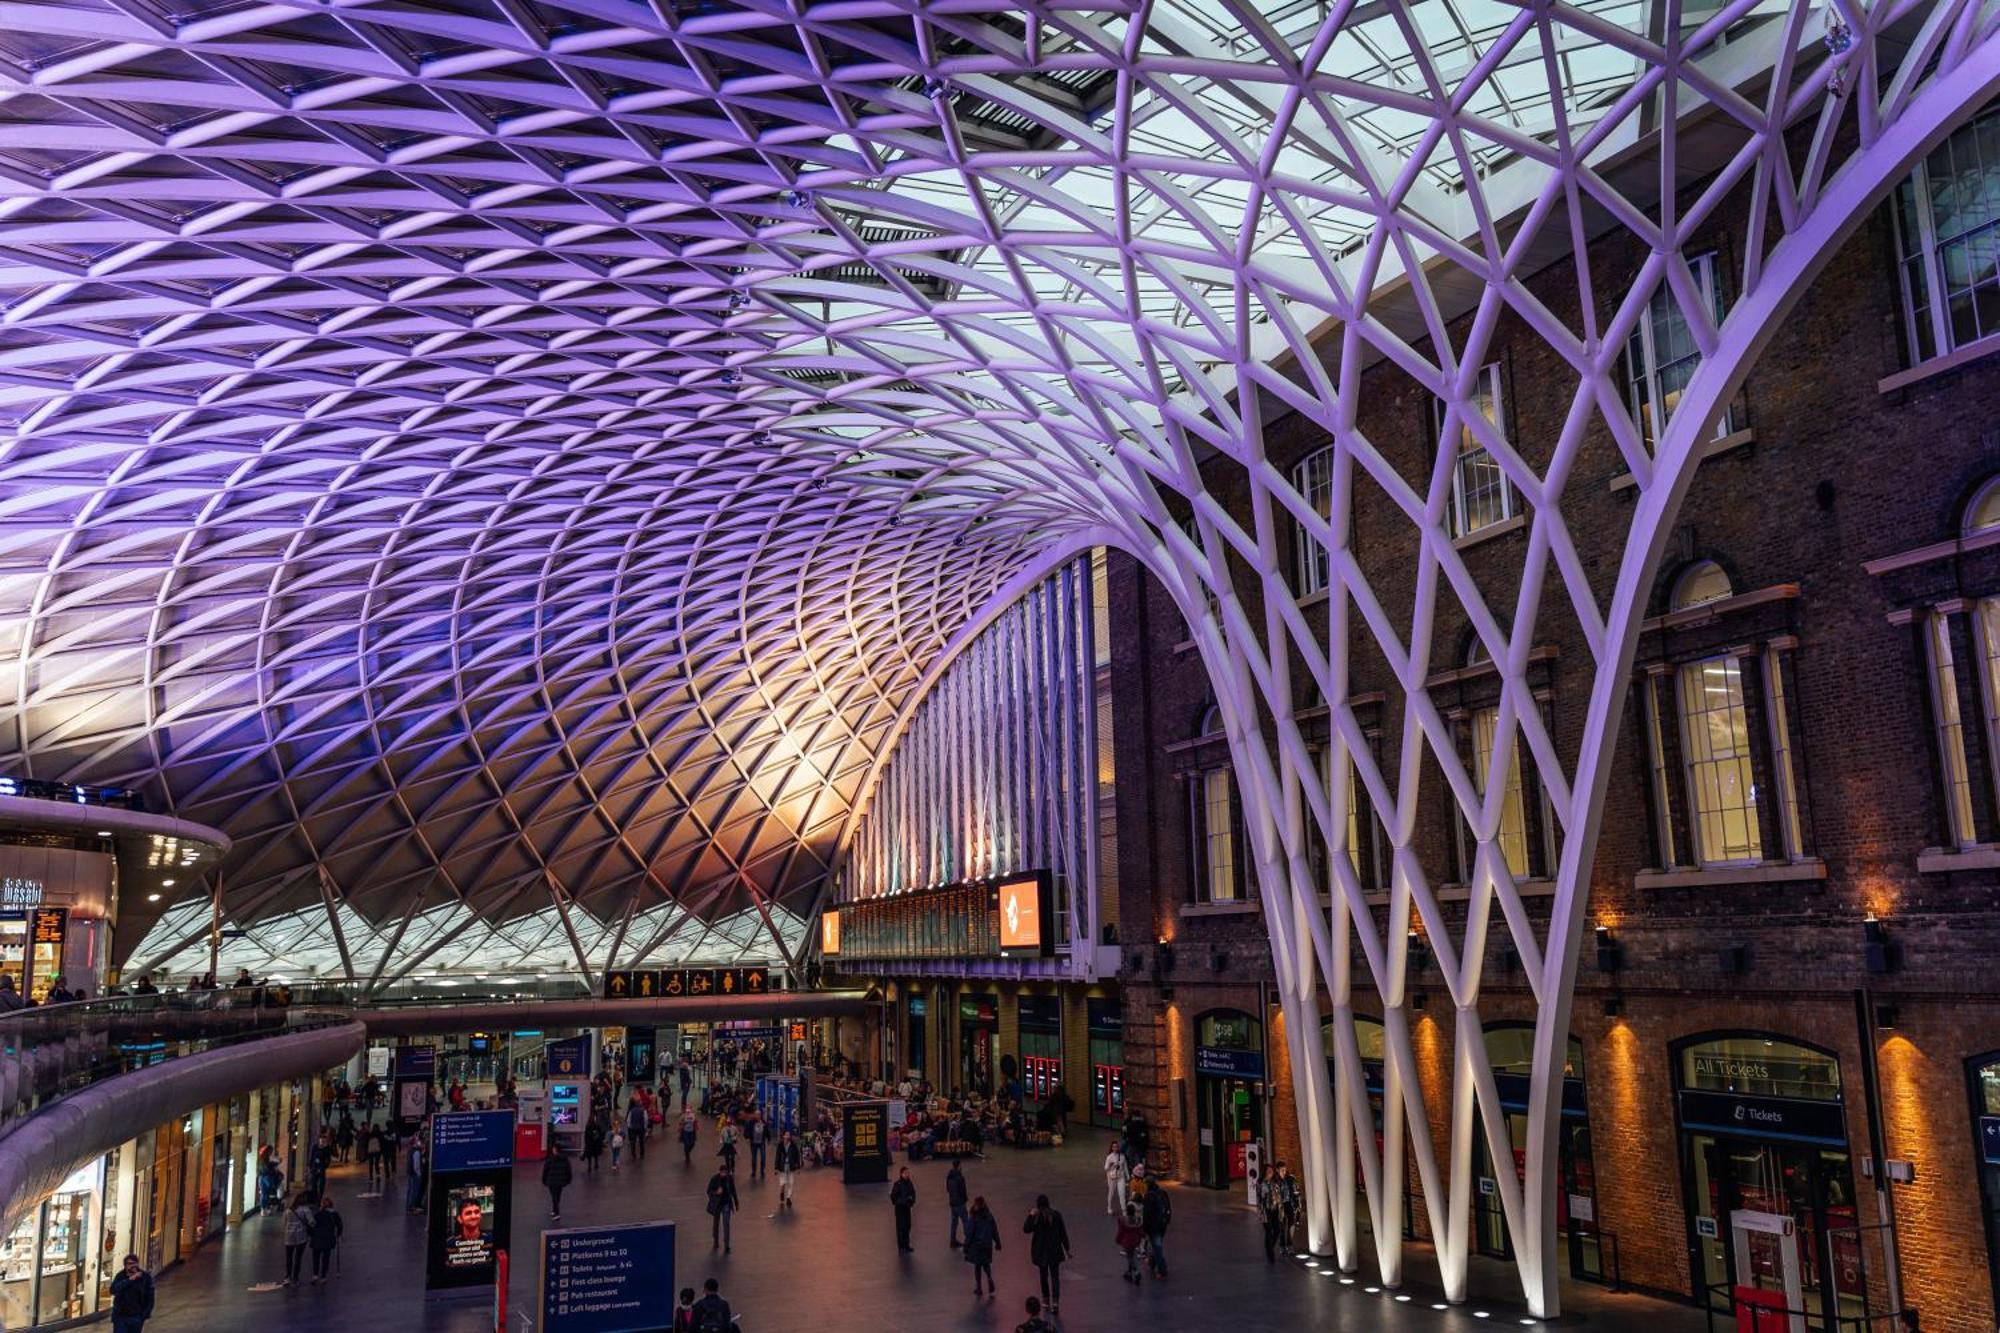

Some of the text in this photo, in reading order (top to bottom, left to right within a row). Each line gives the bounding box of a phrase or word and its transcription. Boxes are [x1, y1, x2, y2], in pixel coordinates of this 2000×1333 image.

[1695, 1059, 1769, 1078] All Tickets
[1748, 1108, 1783, 1122] Tickets
[572, 1237, 615, 1247] Underground
[571, 1248, 628, 1260] Platforms 9 to 10
[572, 1265, 593, 1273] Toilets
[571, 1275, 626, 1287] First class lounge
[571, 1289, 618, 1299] Pub restaurant
[570, 1303, 584, 1312] Left
[584, 1303, 611, 1313] luggage
